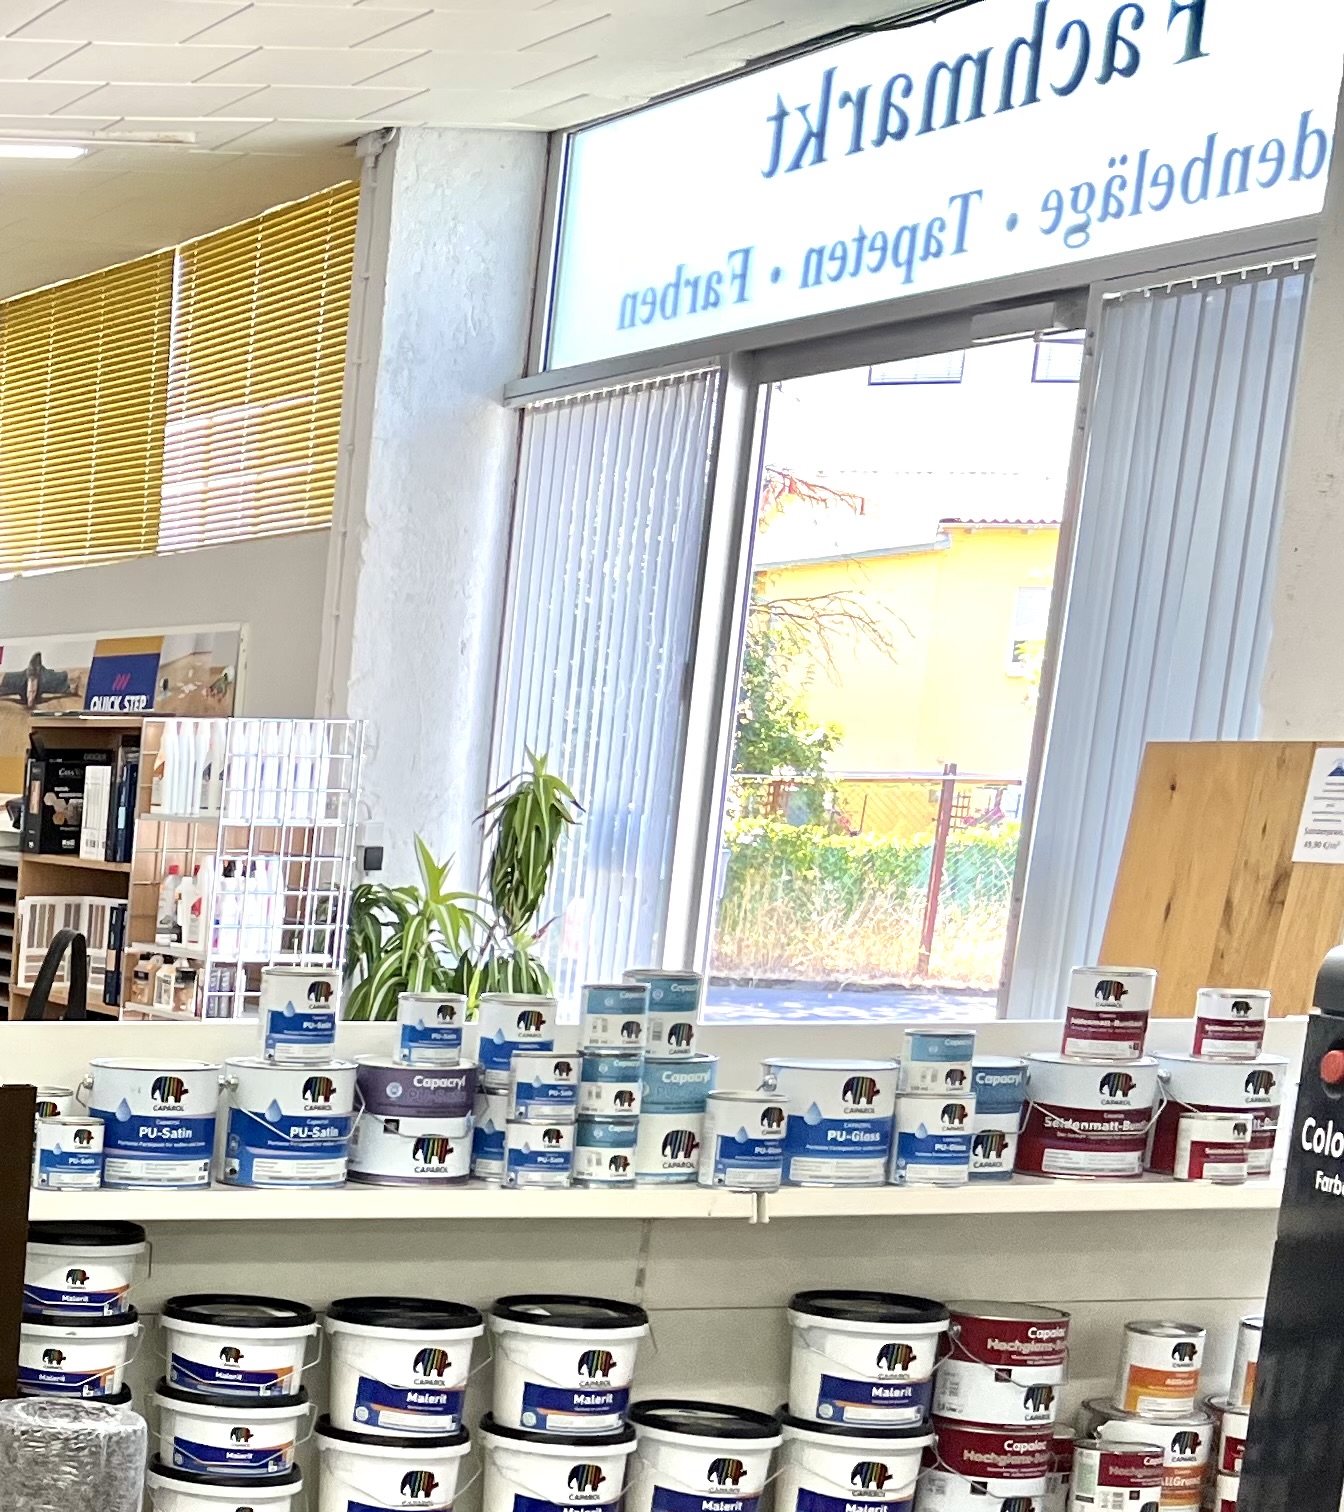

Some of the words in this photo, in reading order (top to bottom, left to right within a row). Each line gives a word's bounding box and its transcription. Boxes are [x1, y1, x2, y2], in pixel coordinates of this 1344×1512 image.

[413, 1074, 466, 1091] Capacryl
[661, 1069, 711, 1086] Capacryl
[975, 1072, 1022, 1086] Capacryl
[138, 1127, 193, 1139] PU-Satin
[289, 1126, 339, 1139] PU-Satin
[414, 1165, 449, 1174] CAPAROL
[662, 1161, 696, 1170] CAPAROL
[406, 1391, 448, 1405] Malerit
[871, 1385, 912, 1399] Malerit
[572, 1393, 613, 1405] Malerit
[701, 1499, 742, 1512] Malerit
